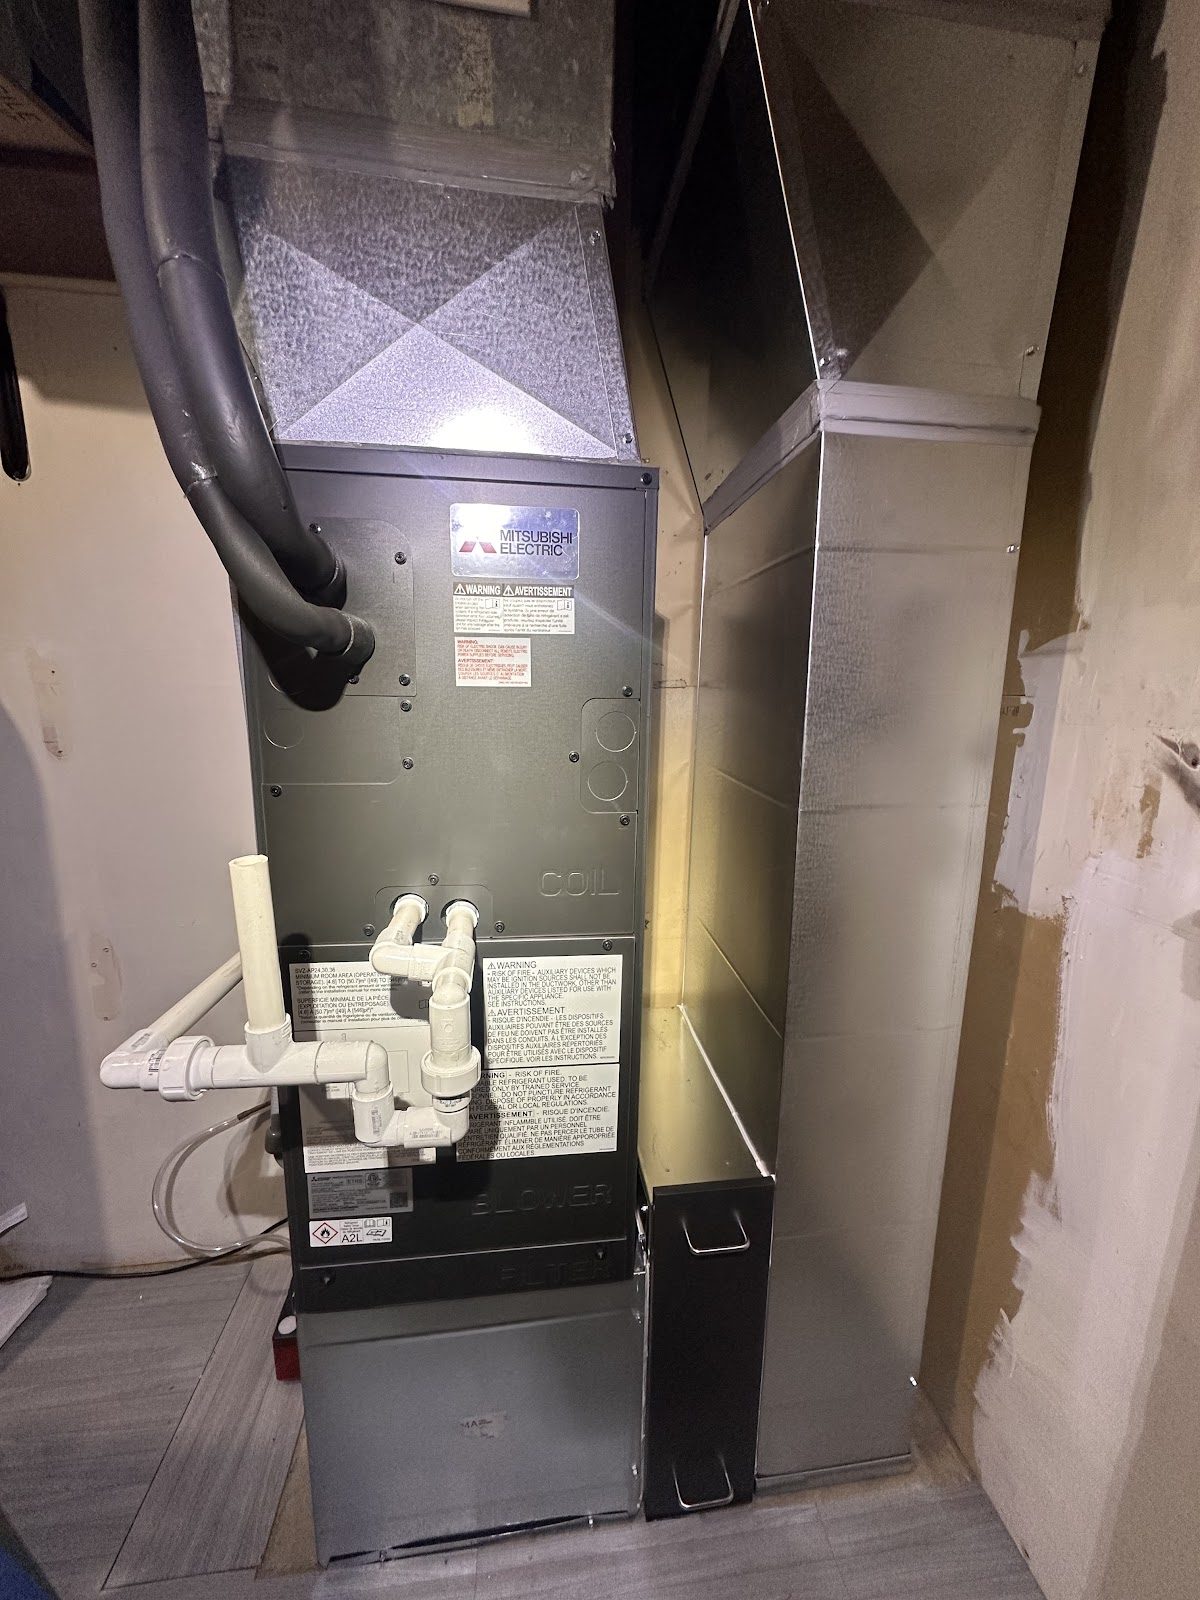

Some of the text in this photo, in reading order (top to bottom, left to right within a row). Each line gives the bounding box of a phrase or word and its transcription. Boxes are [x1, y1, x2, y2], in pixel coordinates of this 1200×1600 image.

[500, 529, 573, 544] MITSUBISHI
[500, 543, 563, 557] ELECTRIC
[466, 584, 573, 597] WARNING AVERTISSEMENT
[540, 871, 621, 897] COIL
[496, 961, 537, 969] WARNING
[496, 1006, 566, 1016] AVERTISSEMENT
[554, 1020, 570, 1028] ÊTRE
[520, 1028, 547, 1036] DOIVENT
[560, 1026, 576, 1034] ÊTRE
[577, 1025, 608, 1033] INSTALLÉS
[556, 1033, 594, 1041] L'EXCEPTION
[525, 1041, 561, 1049] AUXILIAIRES
[480, 1071, 506, 1079] RNING
[498, 1077, 545, 1086] REFRIGERANT
[552, 1081, 580, 1089] SERVICE
[528, 1088, 564, 1096] PUNCTURE
[565, 1086, 612, 1094] REFRIGERANT
[527, 1094, 561, 1102] PROPERLY
[571, 1092, 617, 1100] ACCORDANCE
[476, 1103, 506, 1111] FEDERAL
[518, 1101, 540, 1109] LOCAL
[469, 1110, 532, 1120] AVERTISSEMENT
[542, 1108, 567, 1116] RISQUE
[584, 1113, 600, 1122] ÊTRE
[483, 1125, 525, 1134] UNIQUEMENT
[550, 1121, 587, 1130] PERSONNEL
[553, 1128, 580, 1136] PERCER
[472, 1183, 614, 1216] BLOWER
[342, 1233, 362, 1242] A2L
